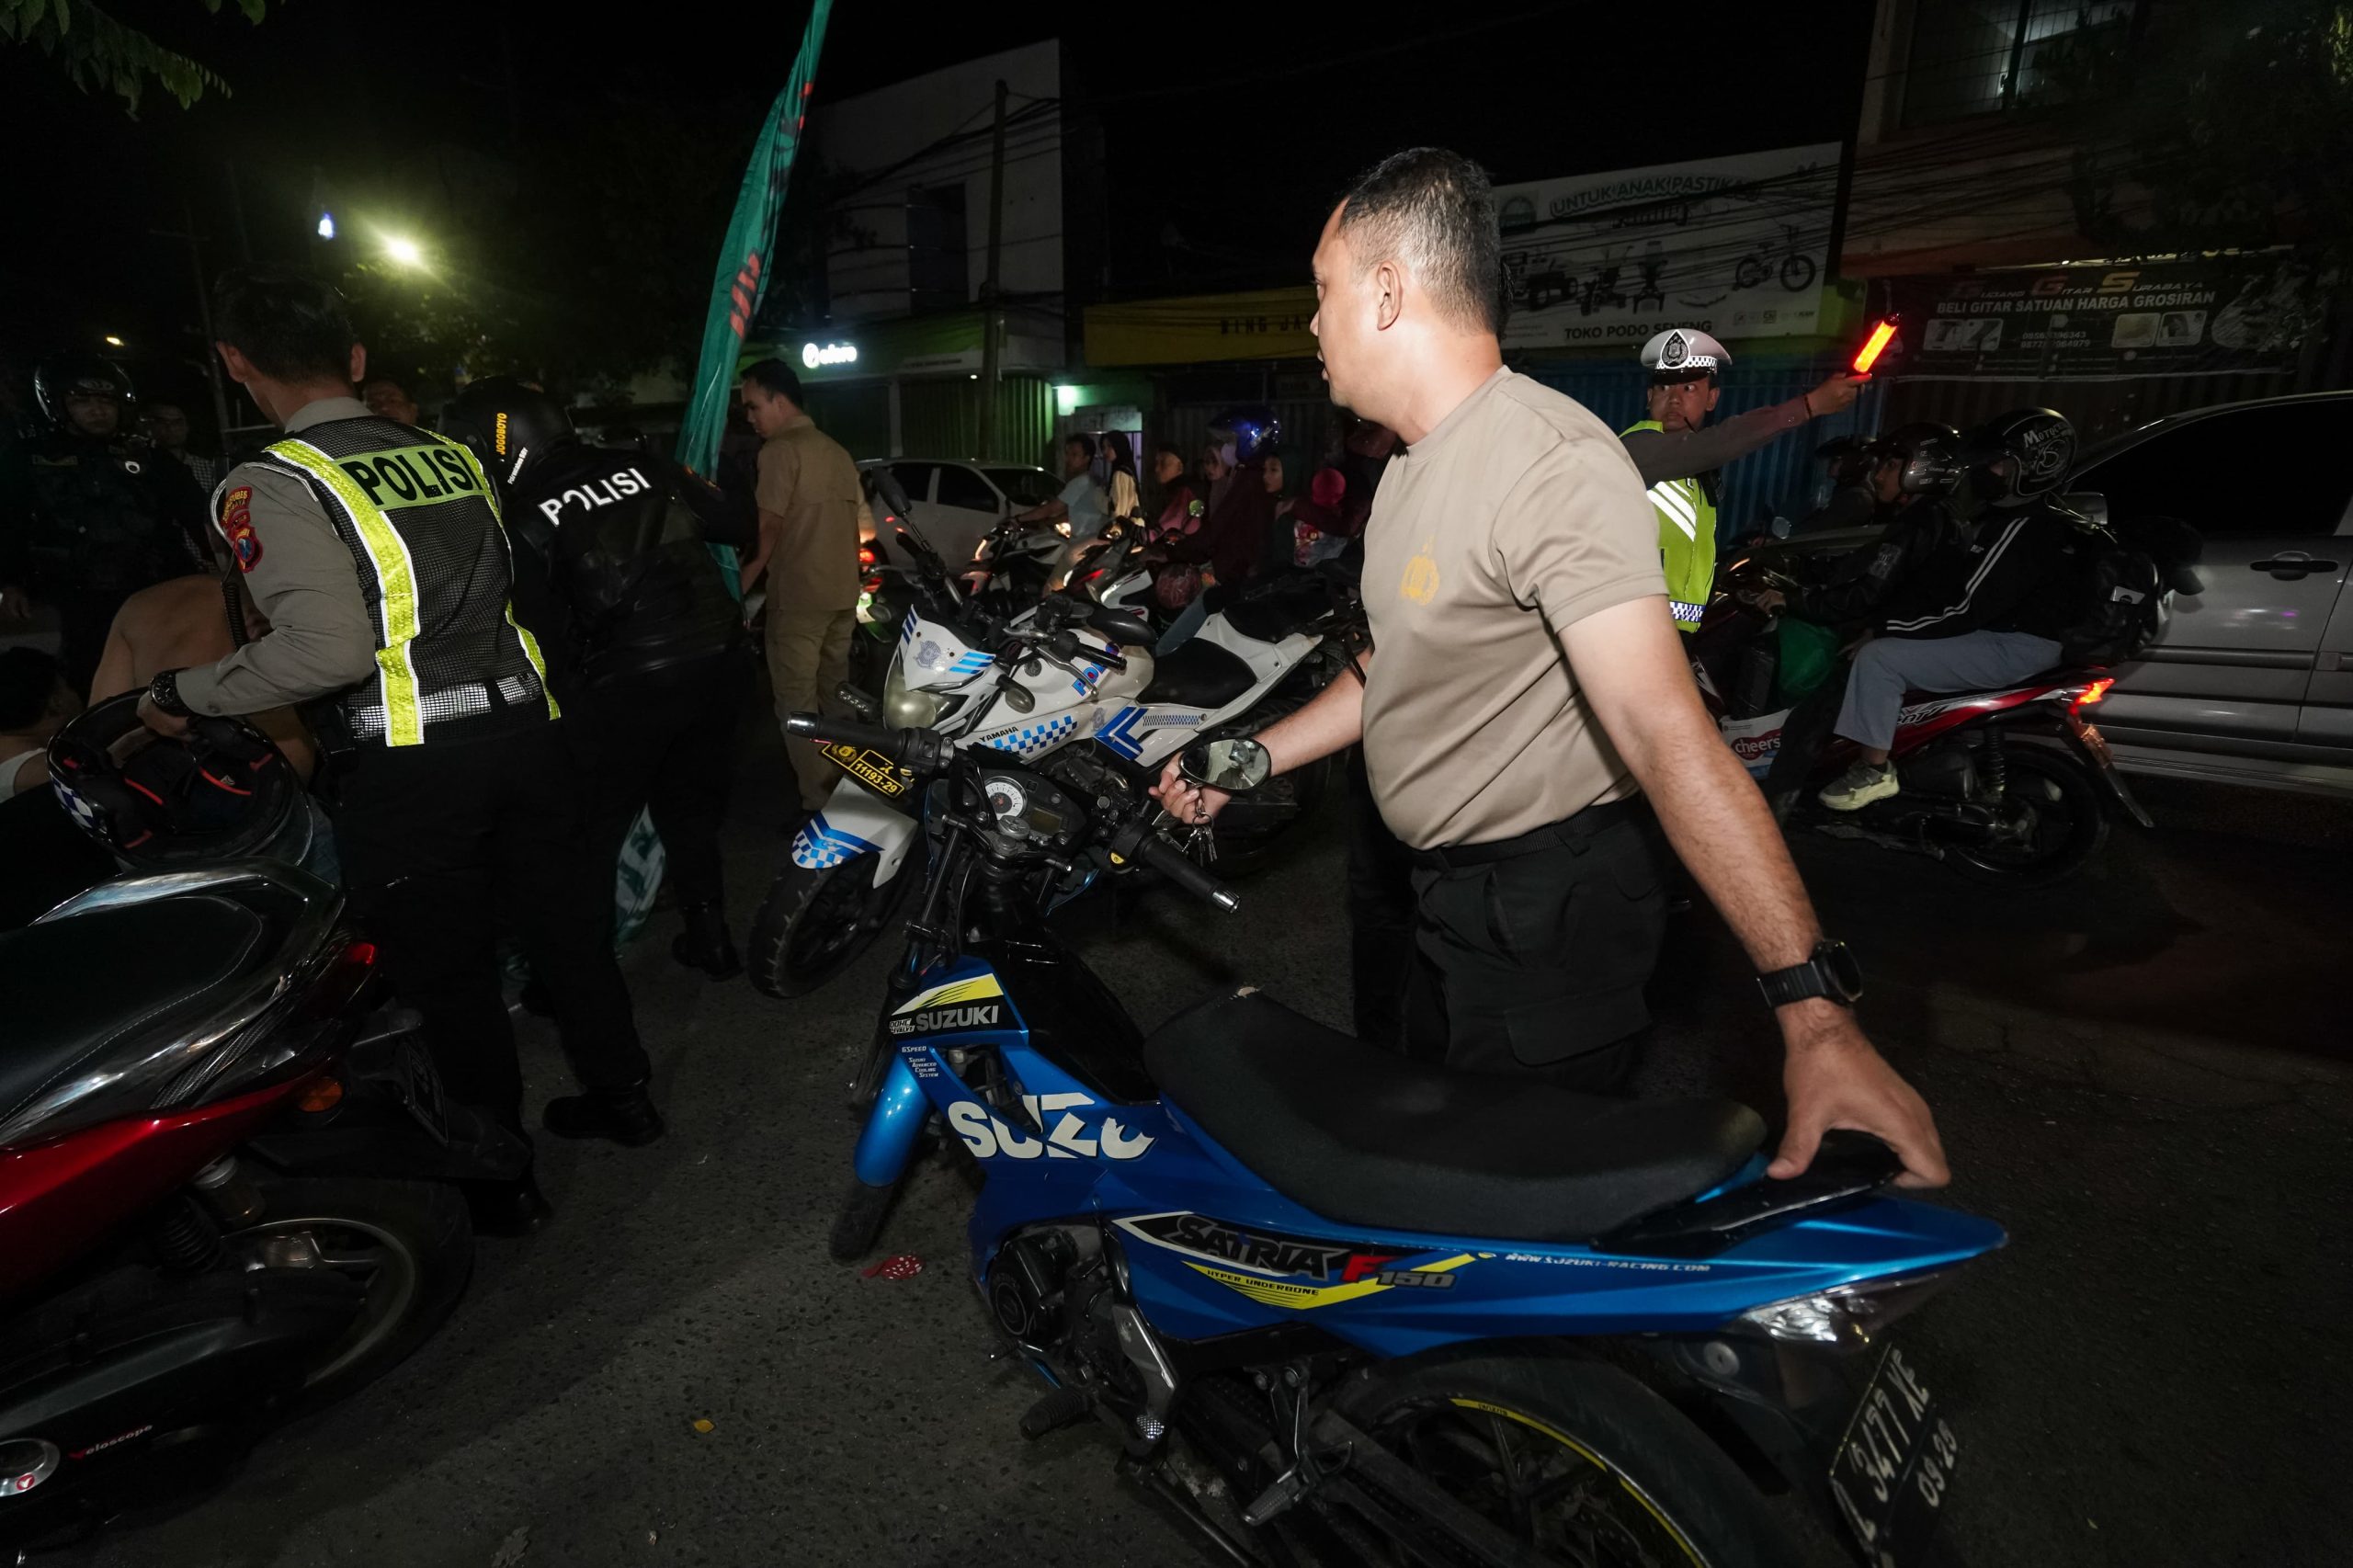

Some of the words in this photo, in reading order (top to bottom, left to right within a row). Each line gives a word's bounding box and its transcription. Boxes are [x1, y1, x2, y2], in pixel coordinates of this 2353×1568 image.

[1937, 301, 1967, 314] BELI
[1970, 301, 2012, 313] GITAR
[2015, 298, 2074, 312] SATUAN
[2076, 296, 2130, 310] HARGA
[2132, 290, 2216, 308] GROSIRAN
[1564, 326, 1602, 340] TOKO
[1606, 324, 1649, 337] PODO
[494, 413, 508, 458] JOGOBOYO
[339, 449, 483, 506] POLISI
[537, 467, 654, 528] POLISI
[979, 726, 1019, 743] YAMAHA
[1734, 737, 1781, 754] cheers
[855, 762, 898, 794] 11193-29
[915, 1005, 999, 1032] SUZUKI
[1167, 1214, 1347, 1281] SATRIA
[1206, 1269, 1243, 1284] HYPER
[1245, 1278, 1320, 1296] UNDERBONE
[1886, 1348, 1929, 1422] XE
